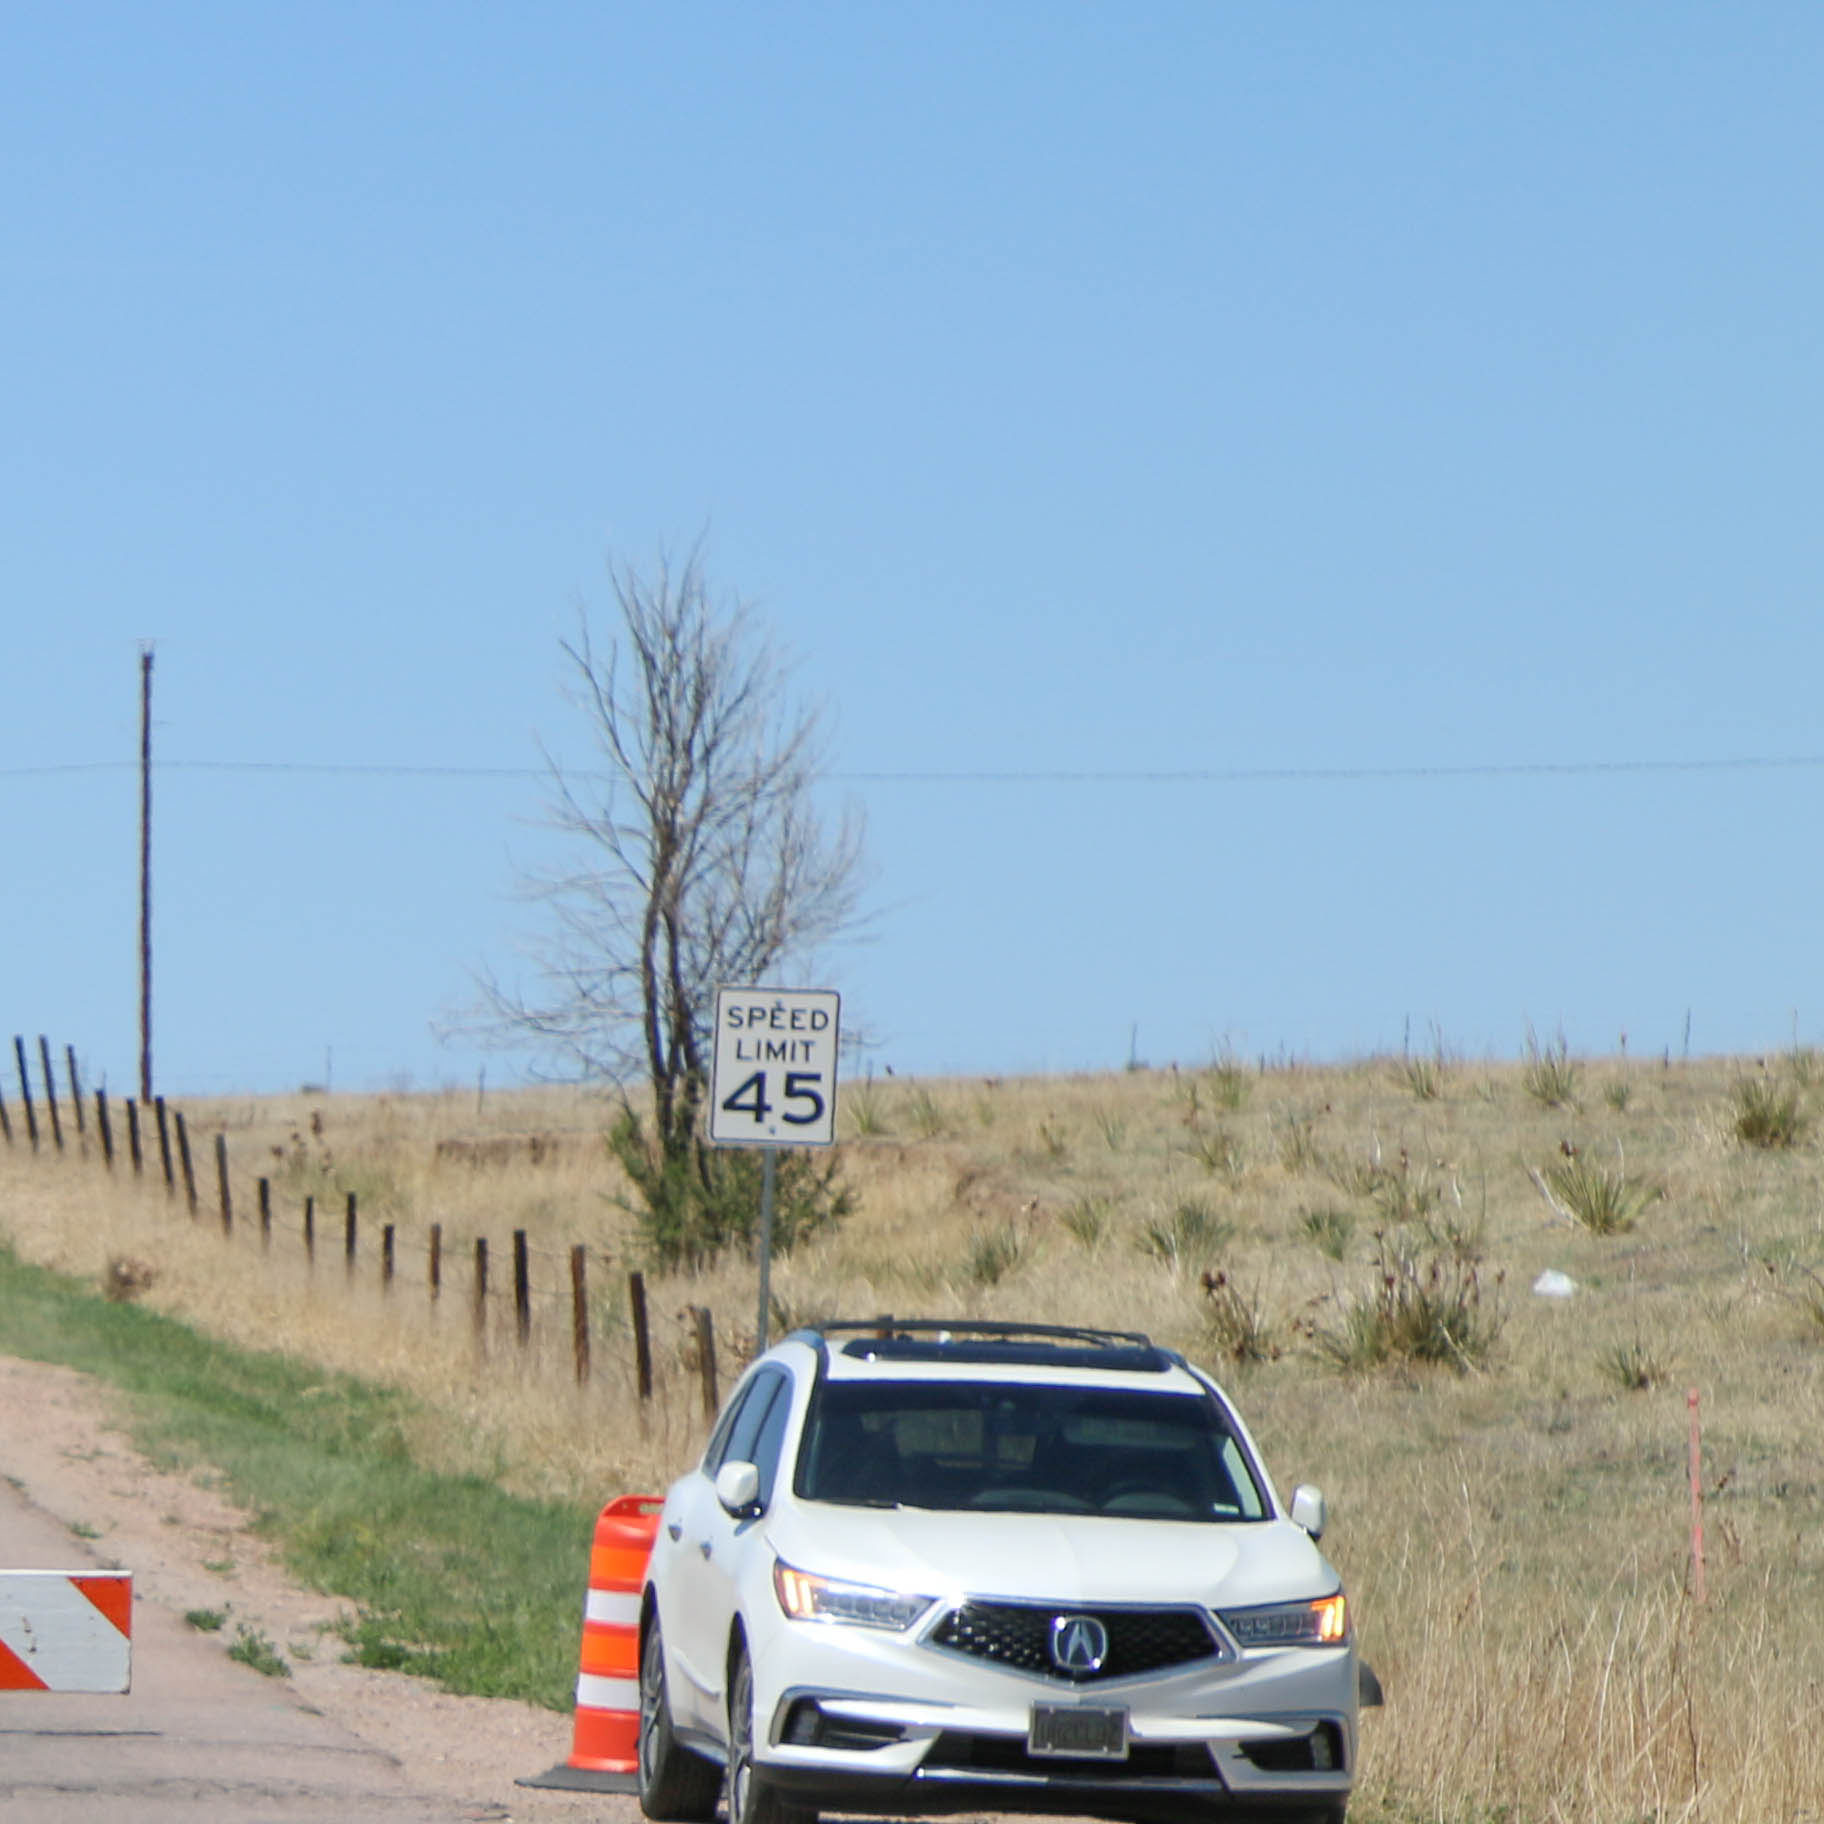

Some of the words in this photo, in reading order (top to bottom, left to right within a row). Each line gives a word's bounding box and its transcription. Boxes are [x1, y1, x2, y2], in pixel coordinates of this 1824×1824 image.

[727, 1005, 829, 1031] SPEED
[735, 1039, 815, 1063] LIMIT
[722, 1071, 825, 1125] 45
